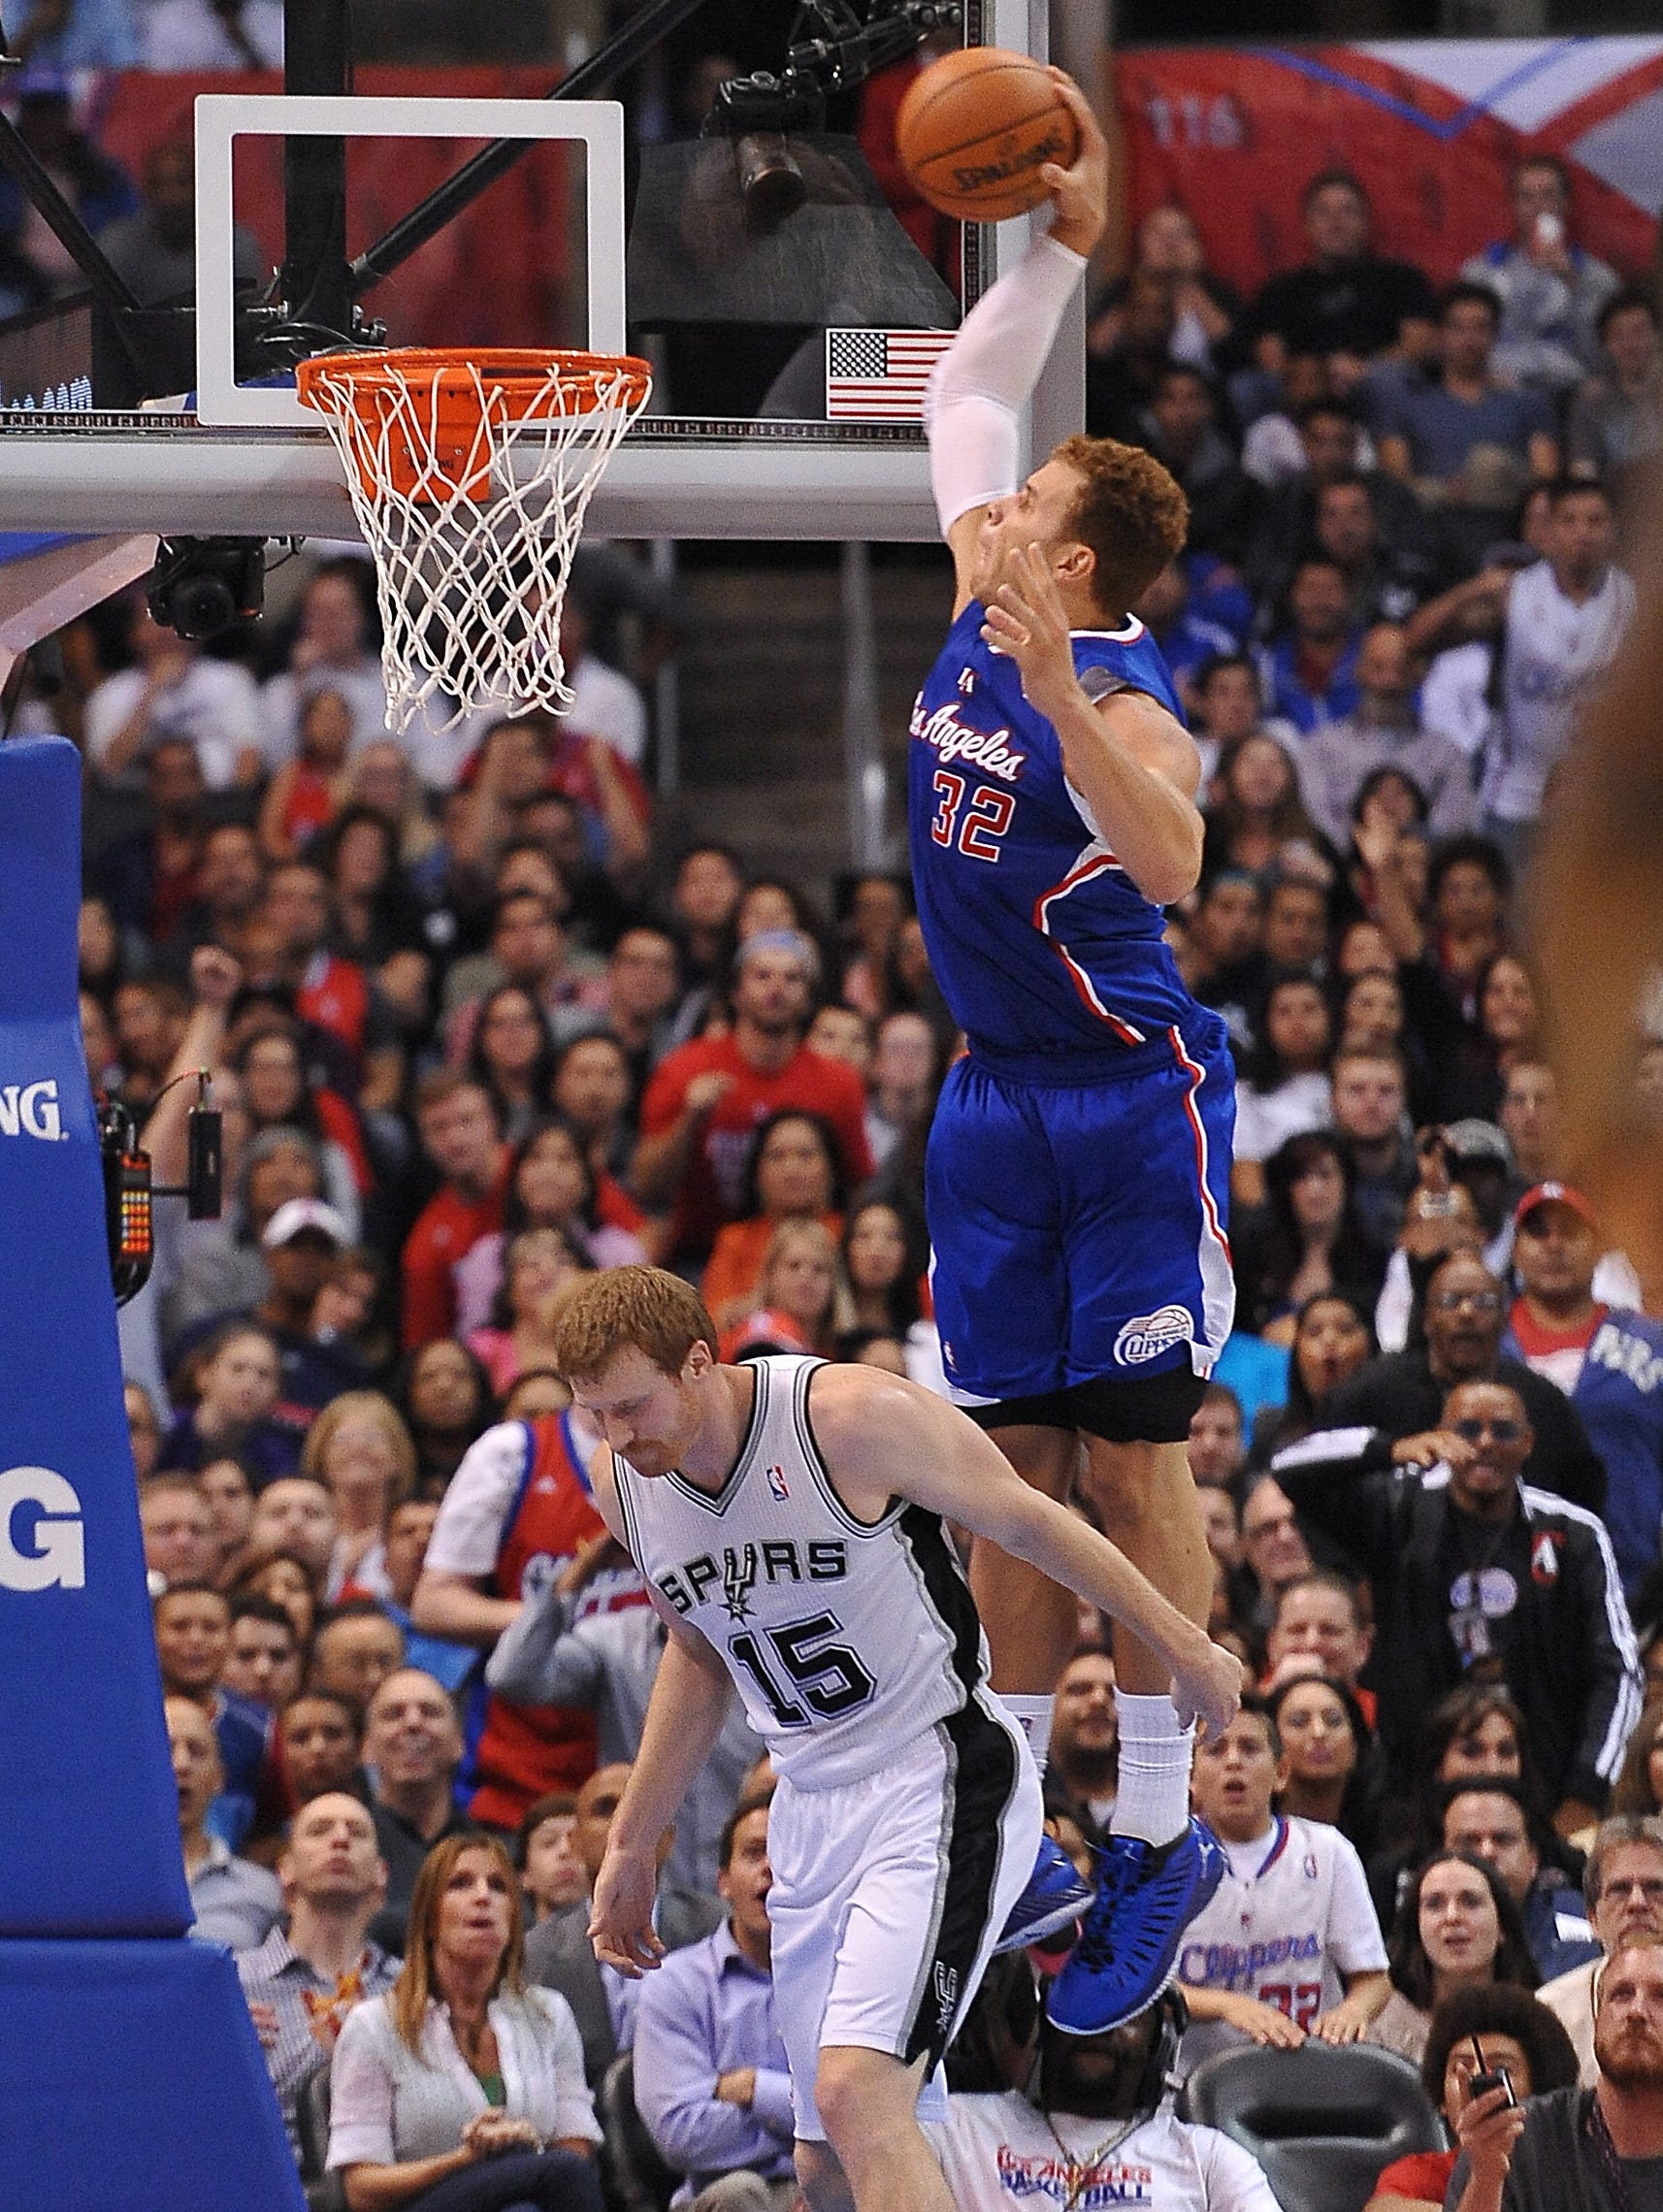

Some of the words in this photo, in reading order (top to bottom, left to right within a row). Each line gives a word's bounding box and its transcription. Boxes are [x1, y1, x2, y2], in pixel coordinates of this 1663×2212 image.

[920, 703, 1025, 782] Angeles
[931, 769, 1017, 863] 32
[0, 1465, 86, 1592] G
[657, 1539, 848, 1625] SPURS
[728, 1609, 878, 1728] 15
